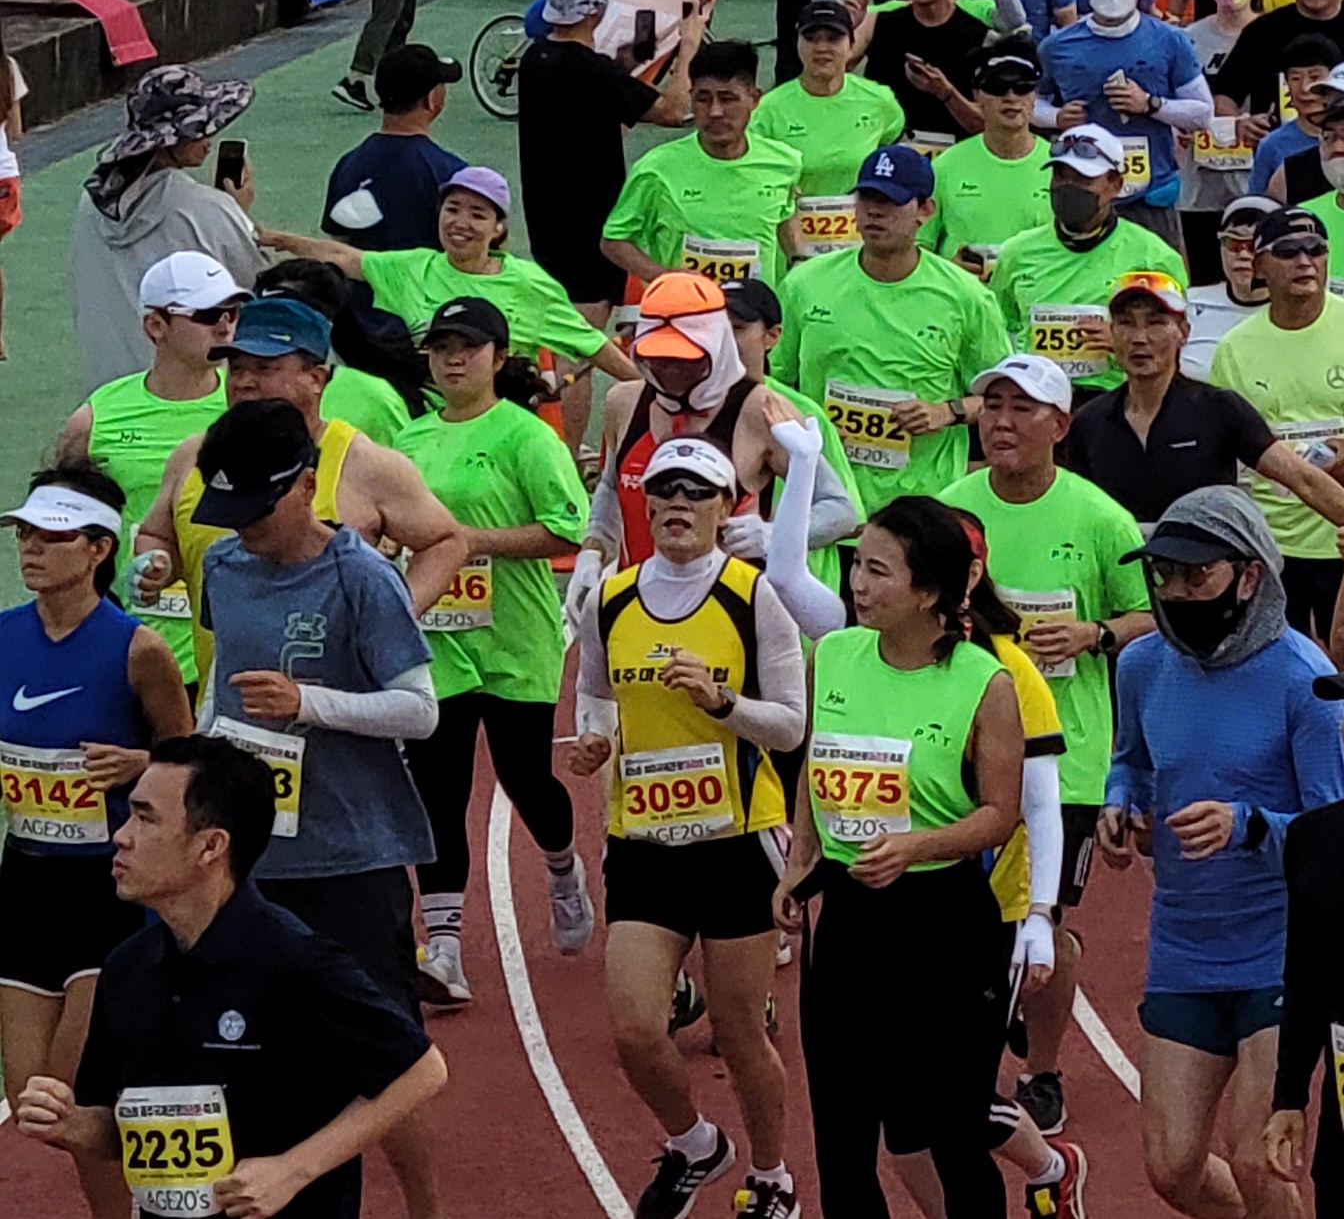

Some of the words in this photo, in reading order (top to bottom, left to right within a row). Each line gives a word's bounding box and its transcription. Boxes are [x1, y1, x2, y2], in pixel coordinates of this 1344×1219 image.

[873, 152, 895, 178] LA
[801, 215, 857, 236] 322
[1035, 328, 1083, 351] 259
[827, 404, 905, 442] 2582
[844, 444, 891, 464] GE20's
[914, 728, 951, 748] PAT
[1, 773, 99, 810] 3142
[626, 775, 723, 816] 3090
[812, 768, 902, 804] 3375
[22, 818, 86, 840] AGE20's
[126, 1127, 224, 1171] 2235
